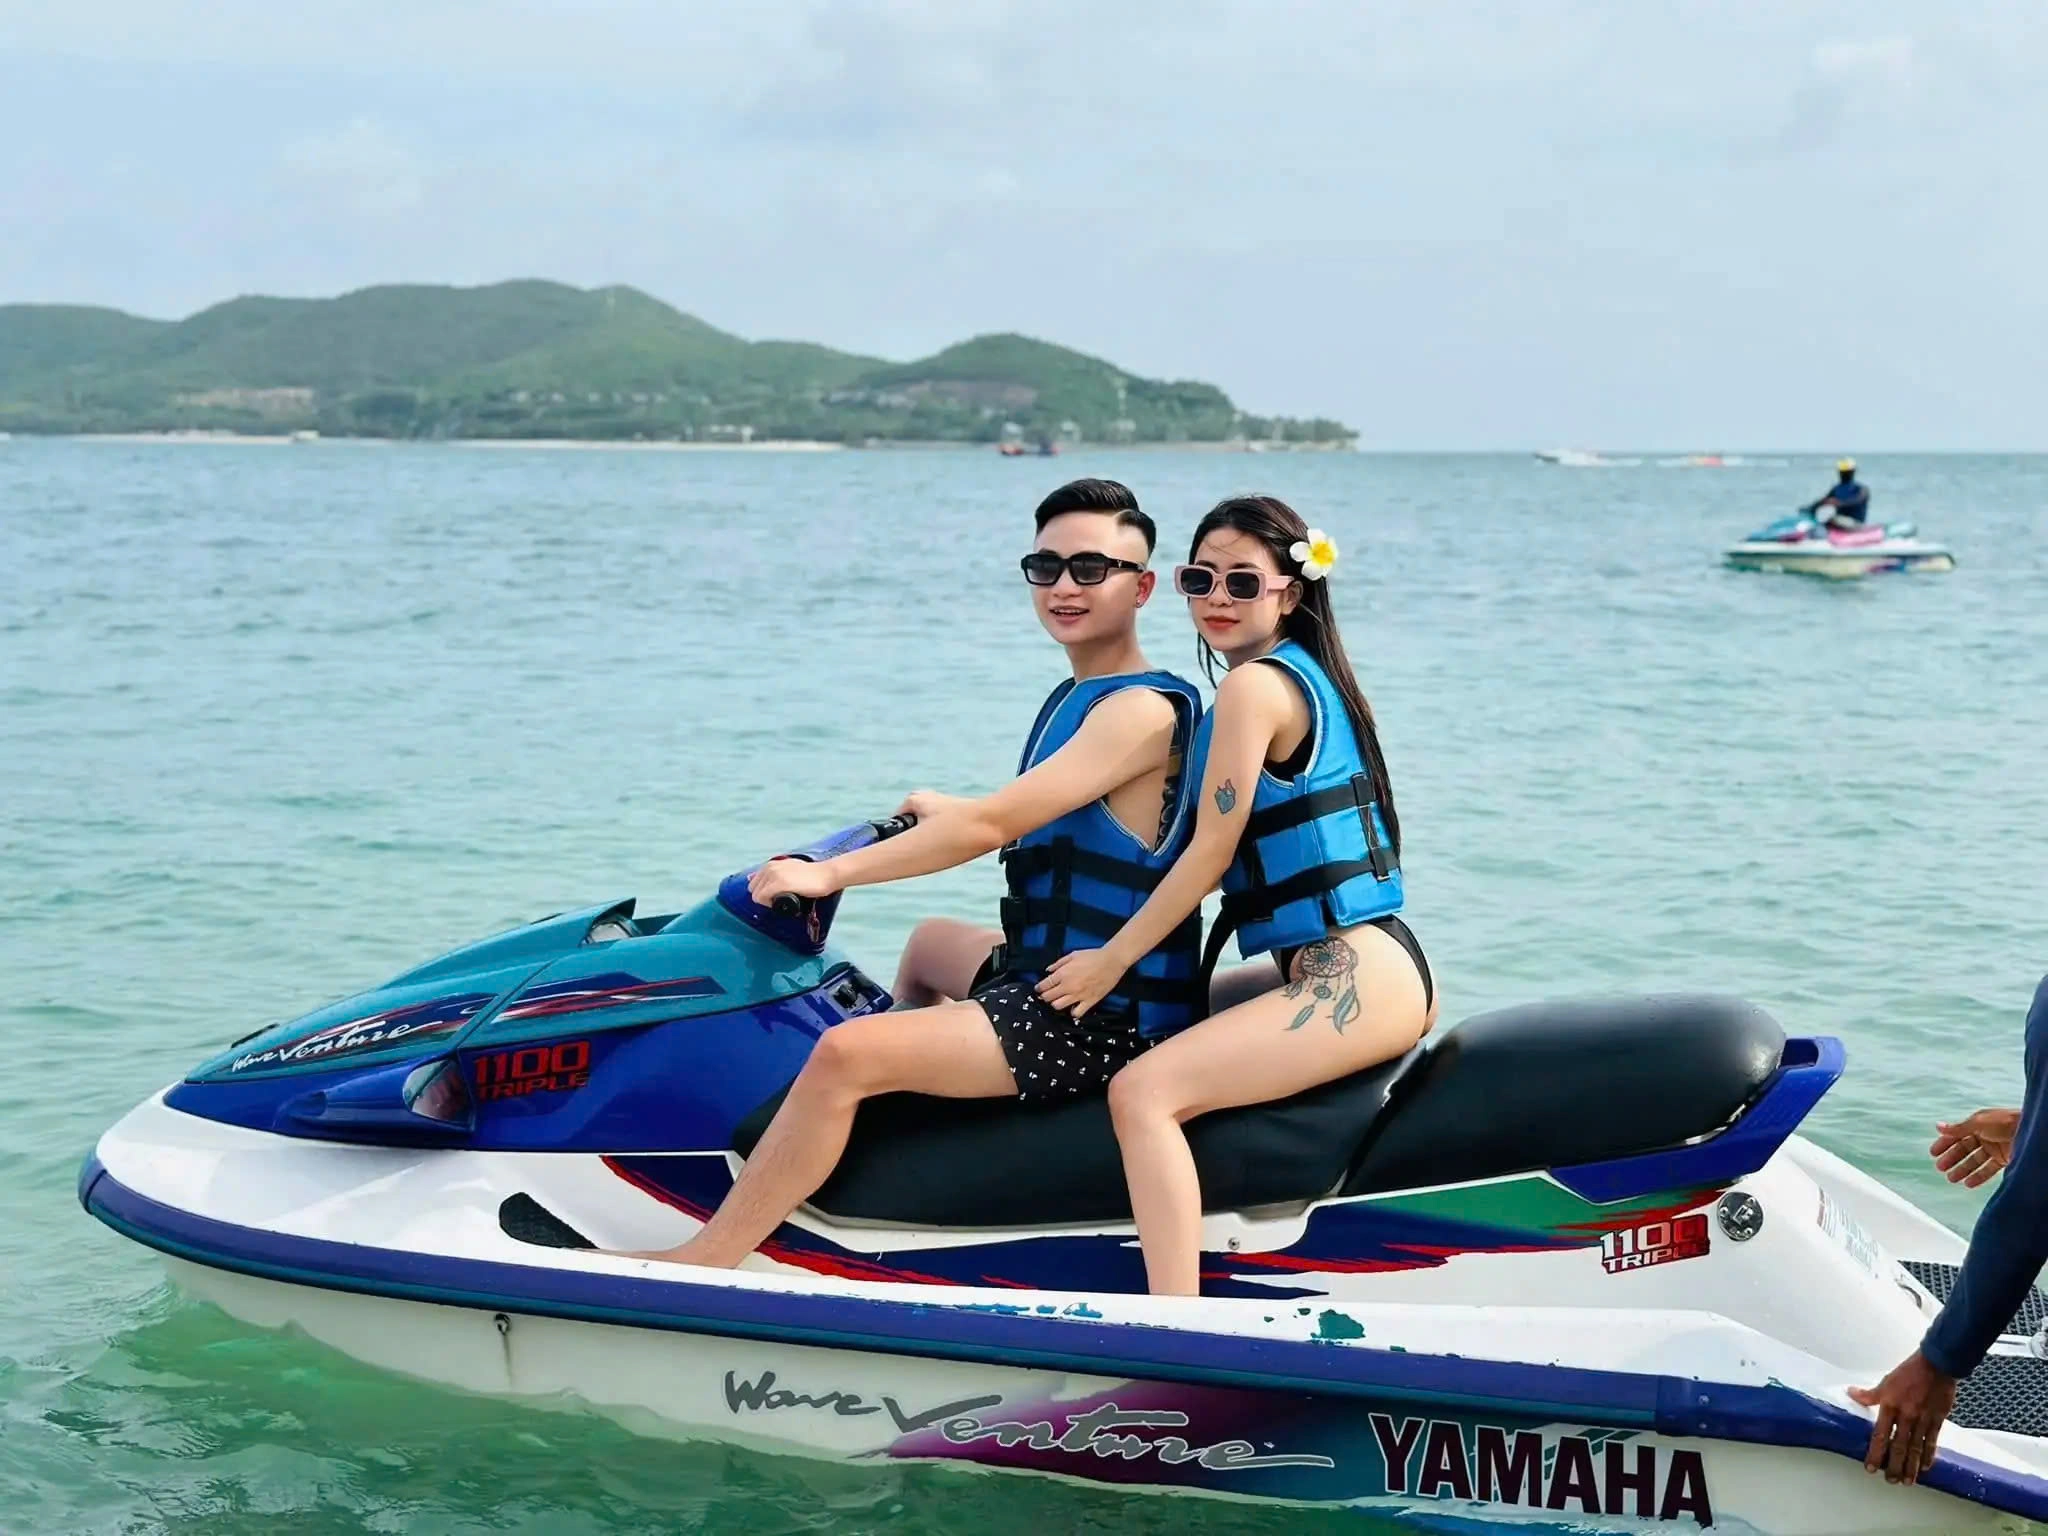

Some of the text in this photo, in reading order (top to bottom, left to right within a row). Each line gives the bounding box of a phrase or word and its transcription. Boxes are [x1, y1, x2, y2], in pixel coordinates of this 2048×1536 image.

[279, 1021, 443, 1062] Venture
[474, 1040, 590, 1085] 1100
[724, 1370, 1335, 1469] Wave Venture
[1368, 1412, 1714, 1528] YAMAHA
